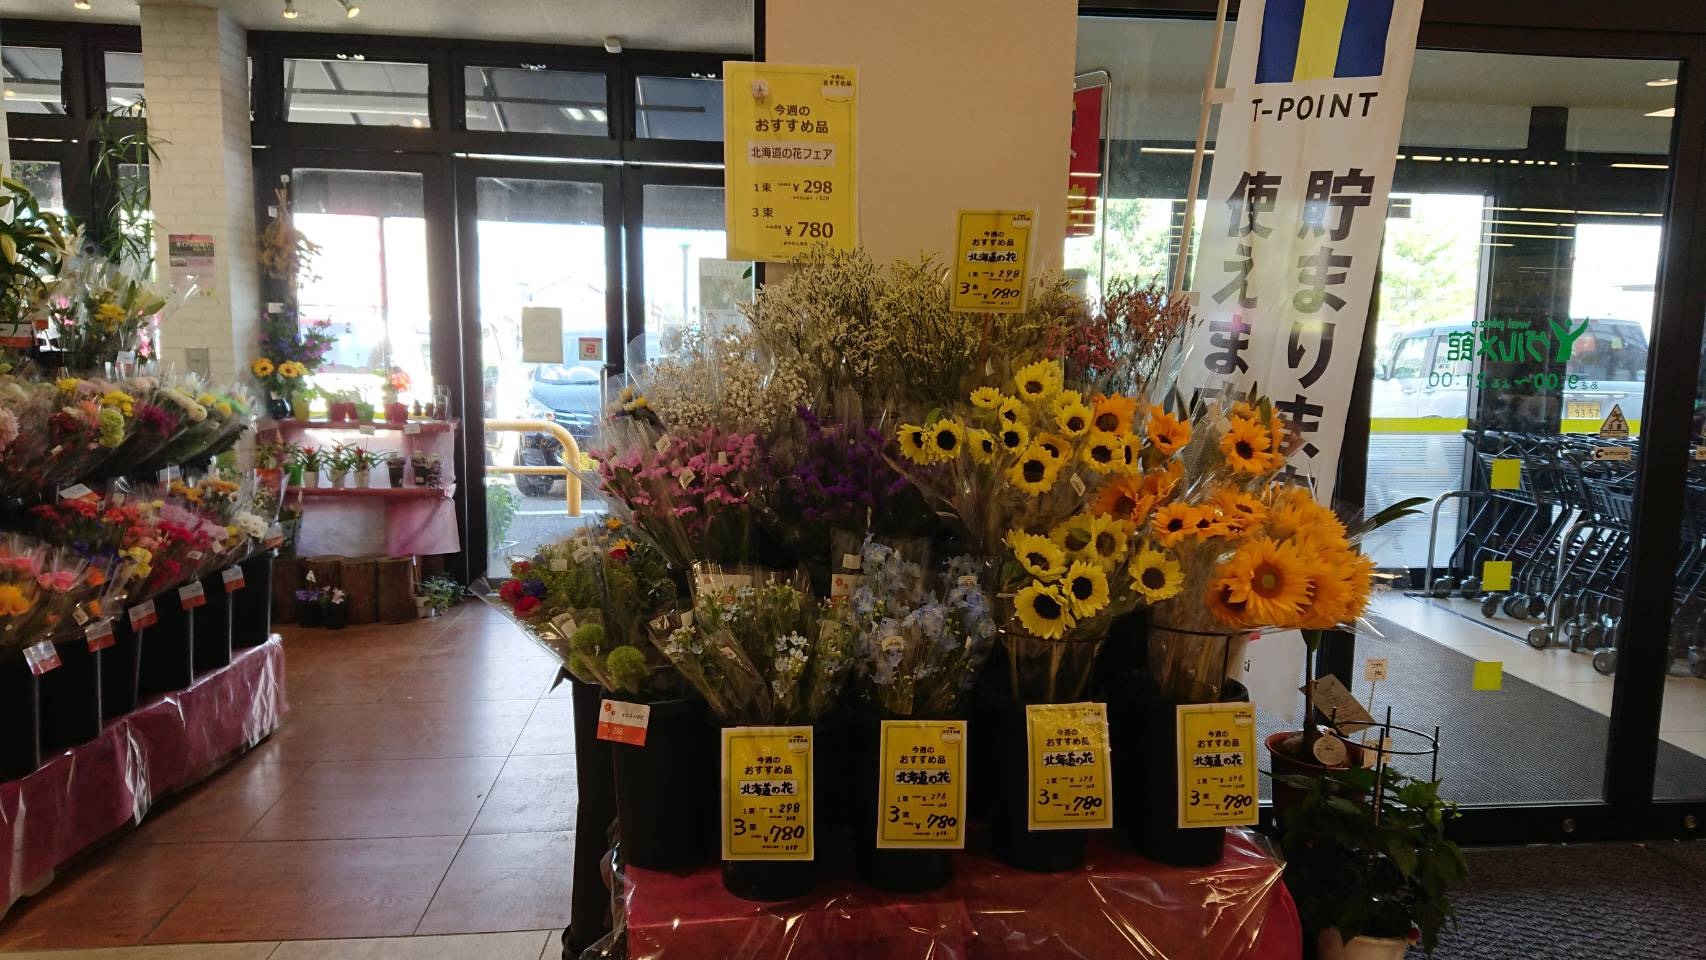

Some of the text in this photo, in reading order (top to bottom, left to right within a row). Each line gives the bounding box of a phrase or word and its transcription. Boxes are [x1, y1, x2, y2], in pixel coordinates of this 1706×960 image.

[774, 104, 810, 117] 今週の
[1252, 92, 1378, 122] T-POINT
[755, 118, 829, 134] おすすめ品
[751, 145, 833, 161] 北海道の花フェア
[1191, 170, 1283, 408] 使えま
[1270, 168, 1376, 490] 貯まりま
[1197, 739, 1239, 748] おすすめ品
[757, 756, 781, 764] 今週の
[900, 756, 946, 764] おすすめ品
[1044, 752, 1094, 767] 北海道の花
[1193, 754, 1242, 767] 北海道の花
[744, 765, 793, 775] おすすめ品
[896, 771, 951, 785] 北海道の花
[741, 781, 794, 797] 北海道の花
